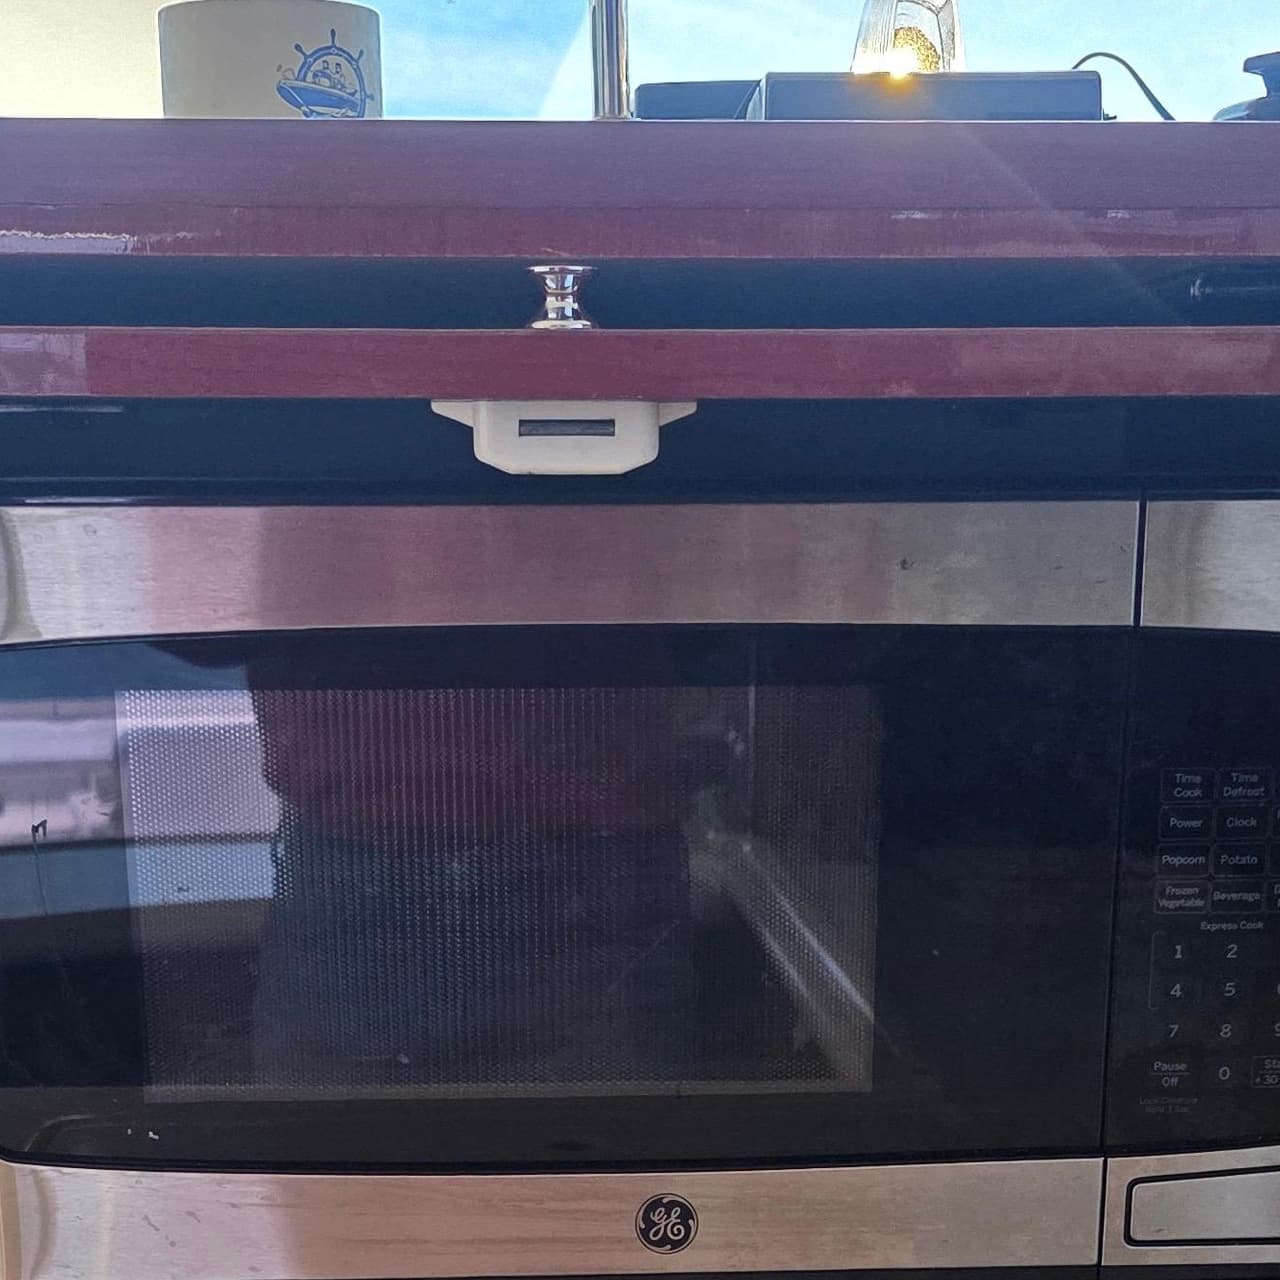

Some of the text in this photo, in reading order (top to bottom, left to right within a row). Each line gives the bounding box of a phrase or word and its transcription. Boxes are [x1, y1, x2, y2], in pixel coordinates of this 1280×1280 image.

[1175, 774, 1202, 783] Time
[1231, 773, 1258, 783] Time
[1174, 788, 1202, 797] Cook
[1224, 787, 1265, 797] Defrost
[1170, 818, 1203, 828] Power
[1226, 817, 1257, 827] Clock
[1162, 855, 1205, 867] Popcorn
[1221, 855, 1258, 865] Potato
[1166, 886, 1199, 896] Frozen
[1213, 891, 1261, 902] Beverage
[1159, 898, 1205, 909] Vegetable
[1200, 920, 1264, 932] Express Cook
[1174, 945, 1183, 959] 1
[1226, 945, 1238, 958] 2
[1170, 984, 1181, 998] 4
[1224, 983, 1235, 996] 5
[1170, 1025, 1179, 1038] 7
[1220, 1024, 1232, 1038] 8
[1154, 1062, 1187, 1071] Pause
[1219, 1067, 1231, 1080] 0
[1162, 1077, 1179, 1087] Off
